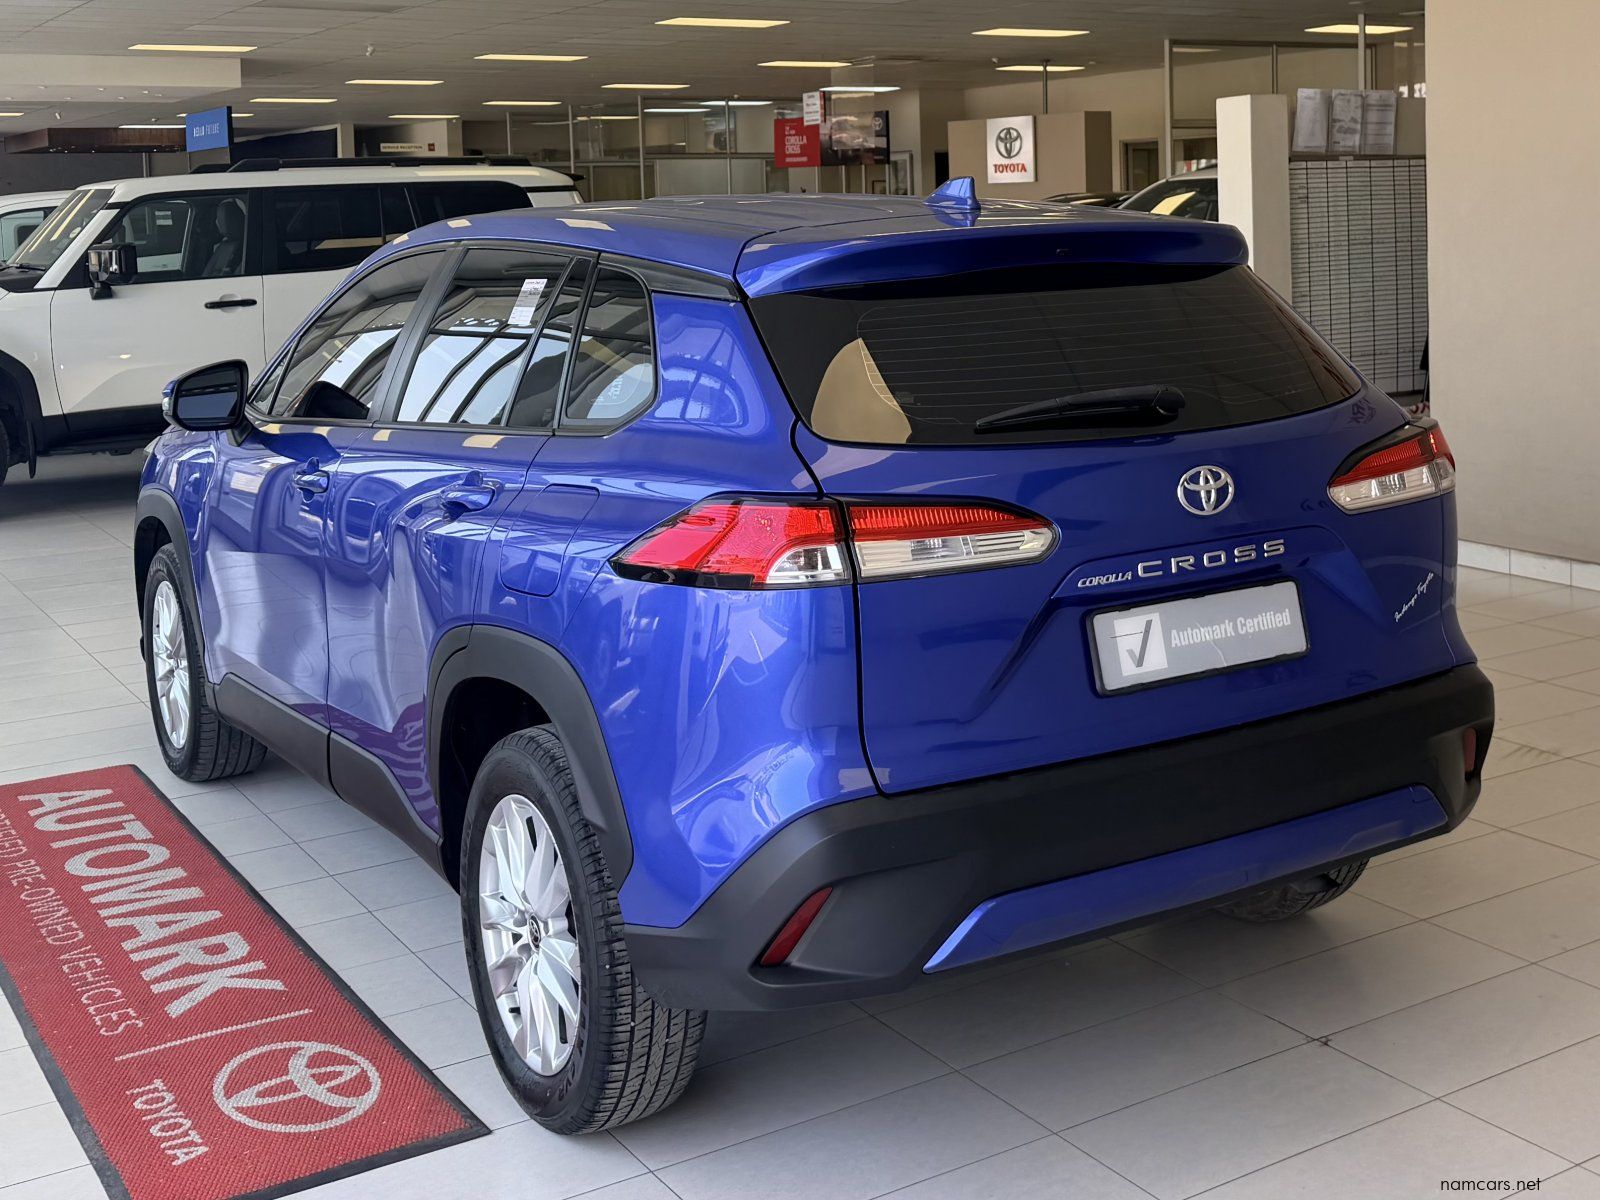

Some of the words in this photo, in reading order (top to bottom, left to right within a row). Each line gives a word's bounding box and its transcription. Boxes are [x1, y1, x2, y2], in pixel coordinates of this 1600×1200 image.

[993, 163, 1027, 173] TOYOTA
[1077, 571, 1132, 588] COROLLA
[1137, 539, 1285, 578] CROSS
[1171, 619, 1236, 648] Automark
[1237, 608, 1292, 635] Certified
[17, 788, 288, 1018] AUTOMARK
[3, 859, 85, 945] PRE-OWNED
[57, 945, 144, 1036] VEHICLES
[125, 1078, 209, 1166] TOYOTA
